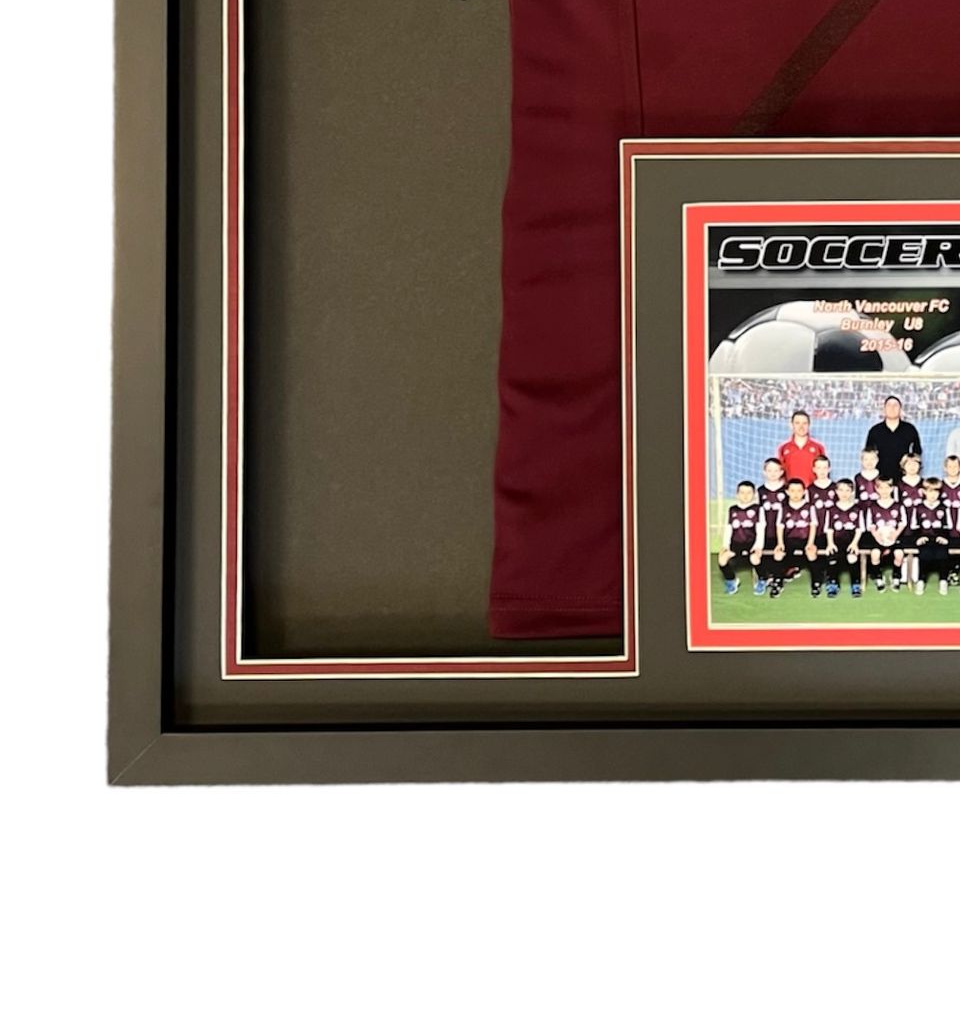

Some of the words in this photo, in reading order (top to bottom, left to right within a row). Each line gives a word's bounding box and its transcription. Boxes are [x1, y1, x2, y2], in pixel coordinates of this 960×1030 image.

[813, 300, 852, 313] North
[855, 299, 927, 313] Vancouver
[928, 298, 950, 313] FC
[840, 317, 894, 333] Burnley
[903, 316, 923, 331] U8
[860, 337, 914, 352] 2015-16
